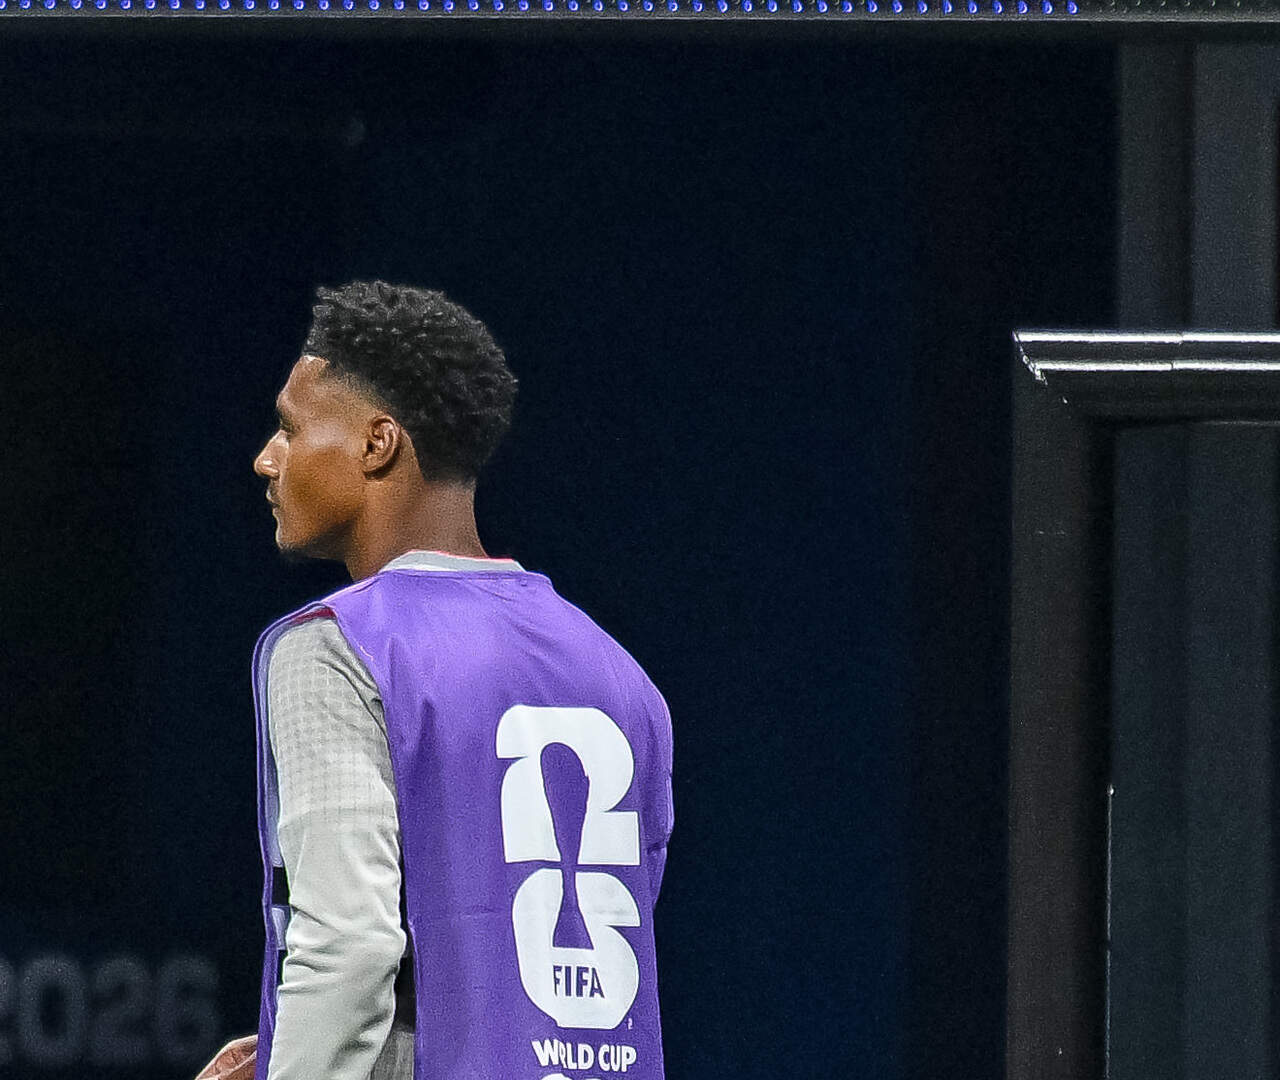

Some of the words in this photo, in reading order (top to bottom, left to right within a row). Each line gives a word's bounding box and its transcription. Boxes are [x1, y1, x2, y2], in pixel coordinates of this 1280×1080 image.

[553, 965, 605, 999] FIFA
[531, 1038, 595, 1070] WRLD
[598, 1043, 637, 1072] CUP
